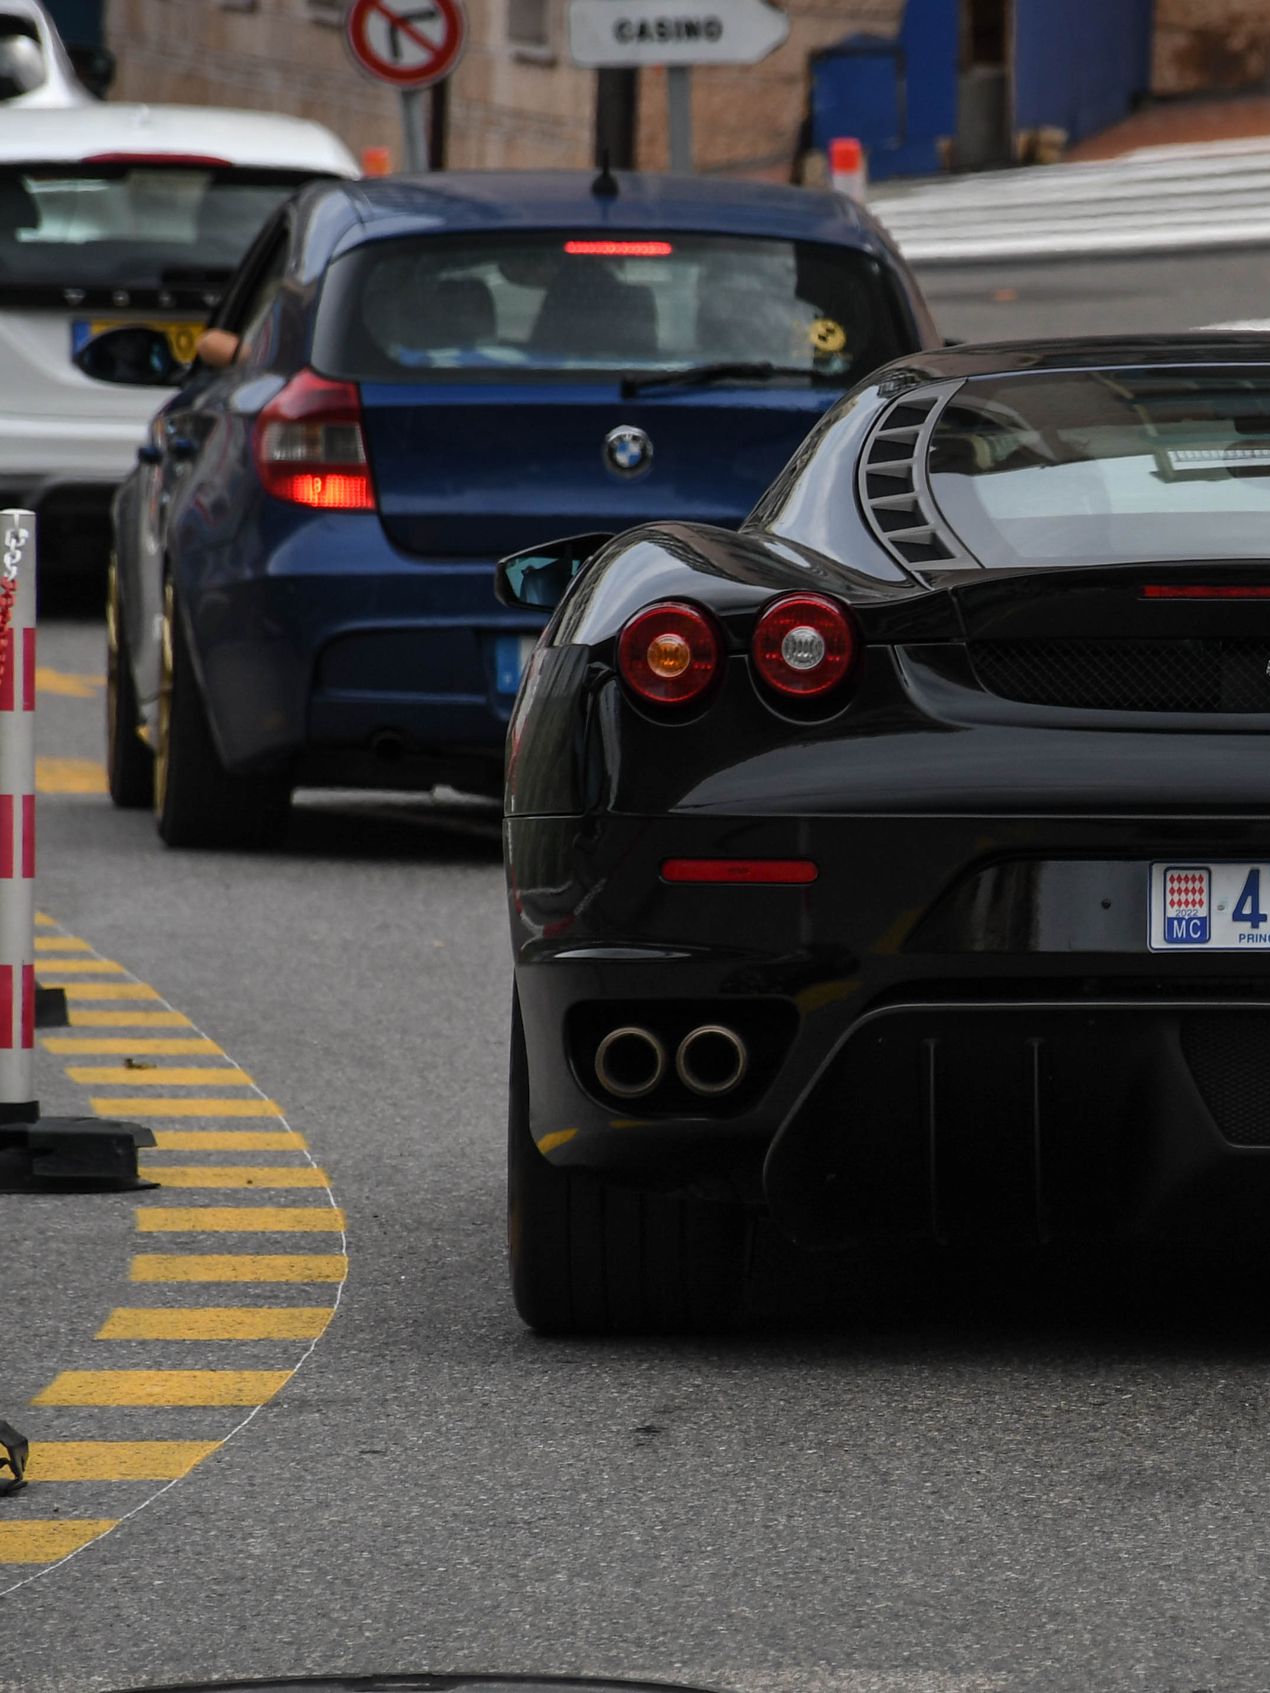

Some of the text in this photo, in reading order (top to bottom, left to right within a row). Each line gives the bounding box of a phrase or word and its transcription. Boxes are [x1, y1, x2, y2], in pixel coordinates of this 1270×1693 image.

[613, 16, 723, 44] CASINO
[1175, 909, 1199, 917] 2022
[1173, 919, 1201, 938] MC
